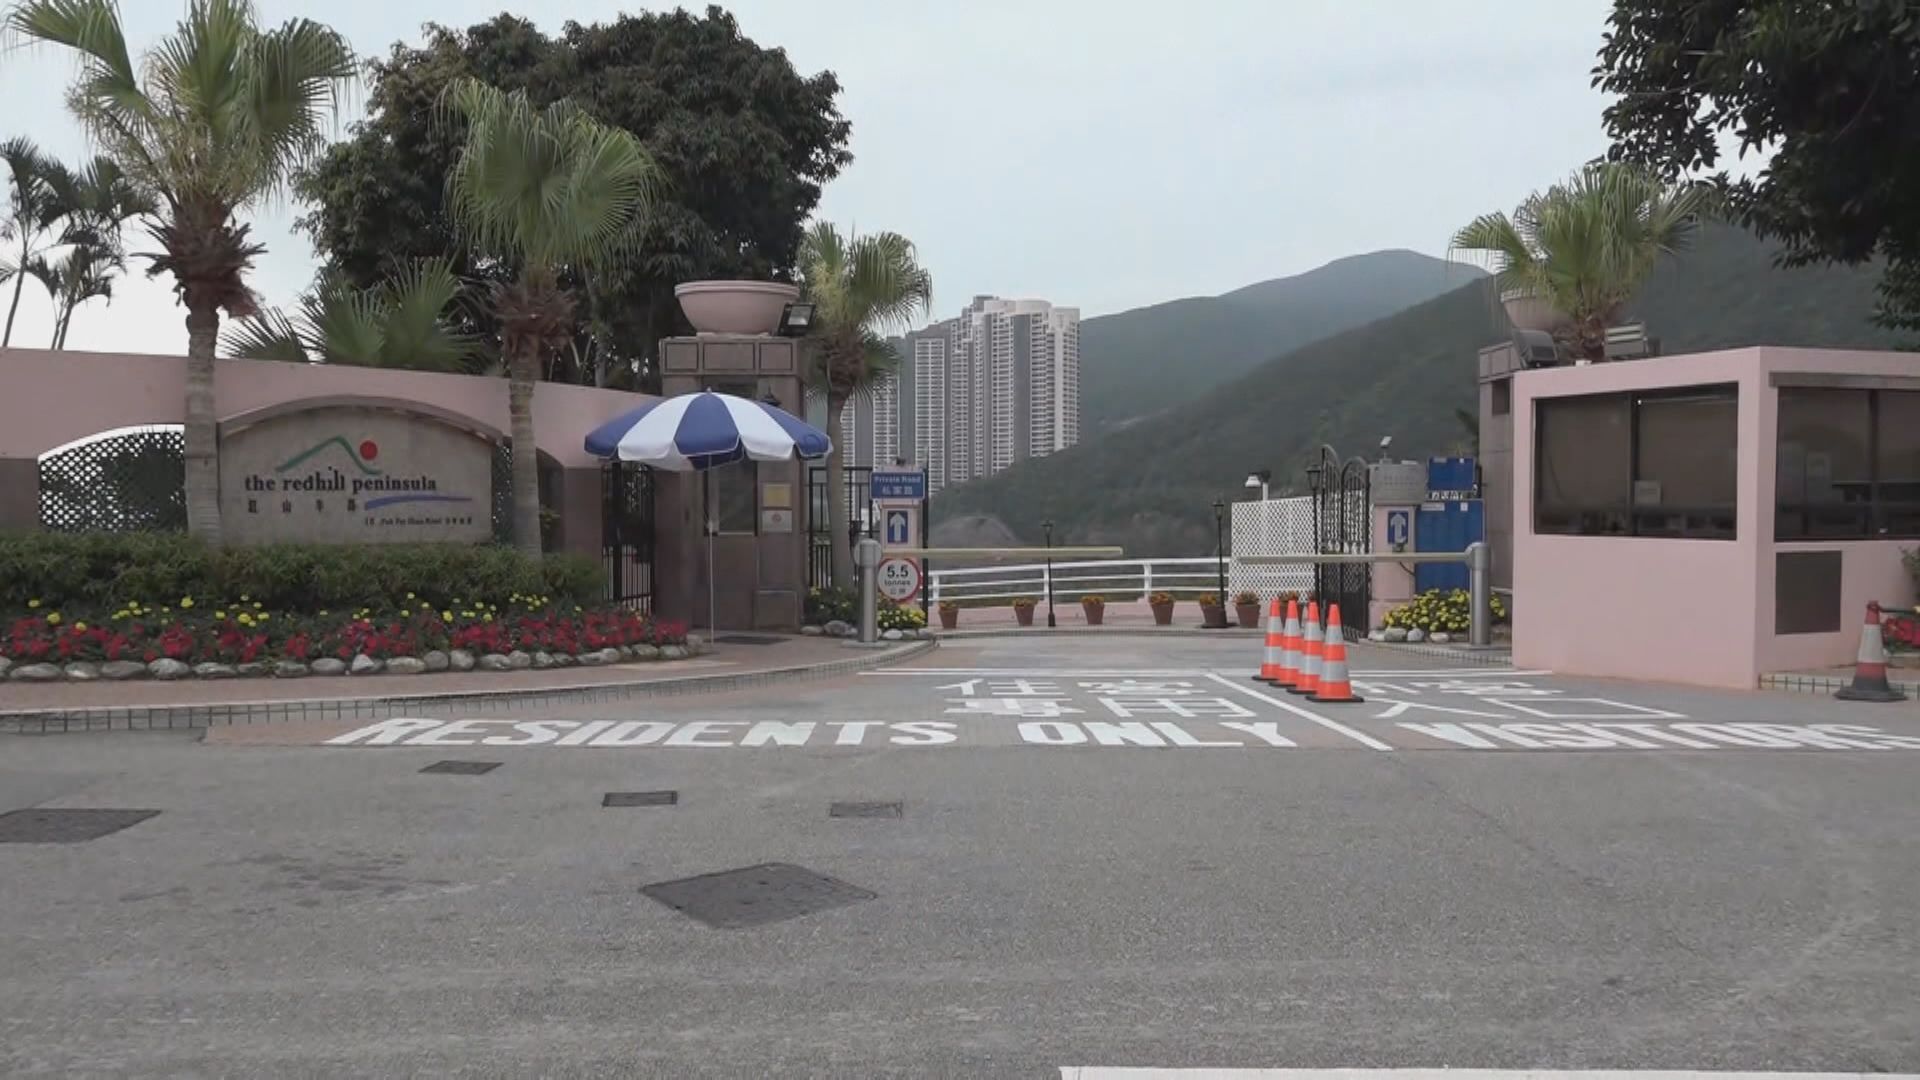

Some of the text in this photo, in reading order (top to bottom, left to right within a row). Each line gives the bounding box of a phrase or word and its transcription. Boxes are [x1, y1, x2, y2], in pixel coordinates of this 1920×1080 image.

[244, 466, 436, 494] the redhill peninsula
[873, 475, 921, 483] Private Road
[887, 565, 909, 578] 5.5
[321, 717, 1298, 748] RESIDENTS ONLY
[1394, 721, 1920, 750] VISITORS
